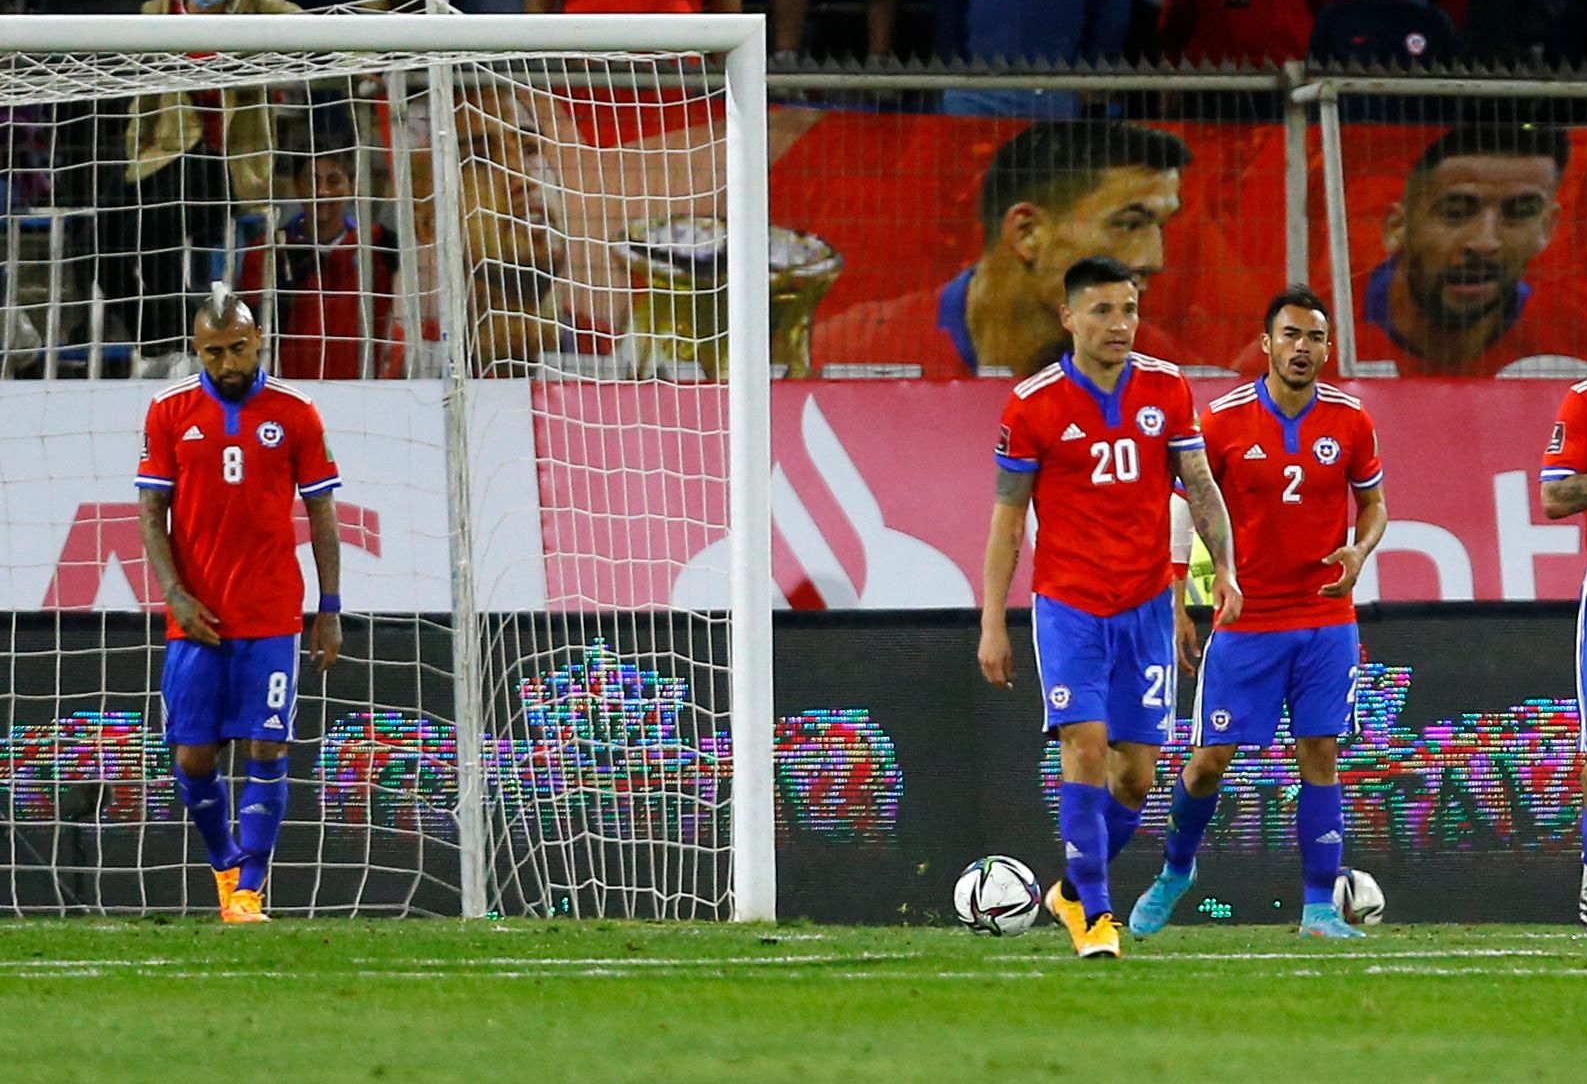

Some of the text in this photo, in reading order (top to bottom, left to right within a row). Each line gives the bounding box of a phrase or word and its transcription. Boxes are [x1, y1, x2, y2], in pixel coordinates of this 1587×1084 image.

[222, 445, 245, 484] 8
[1090, 438, 1139, 484] 20
[1282, 465, 1303, 504] 2
[267, 672, 287, 709] 8
